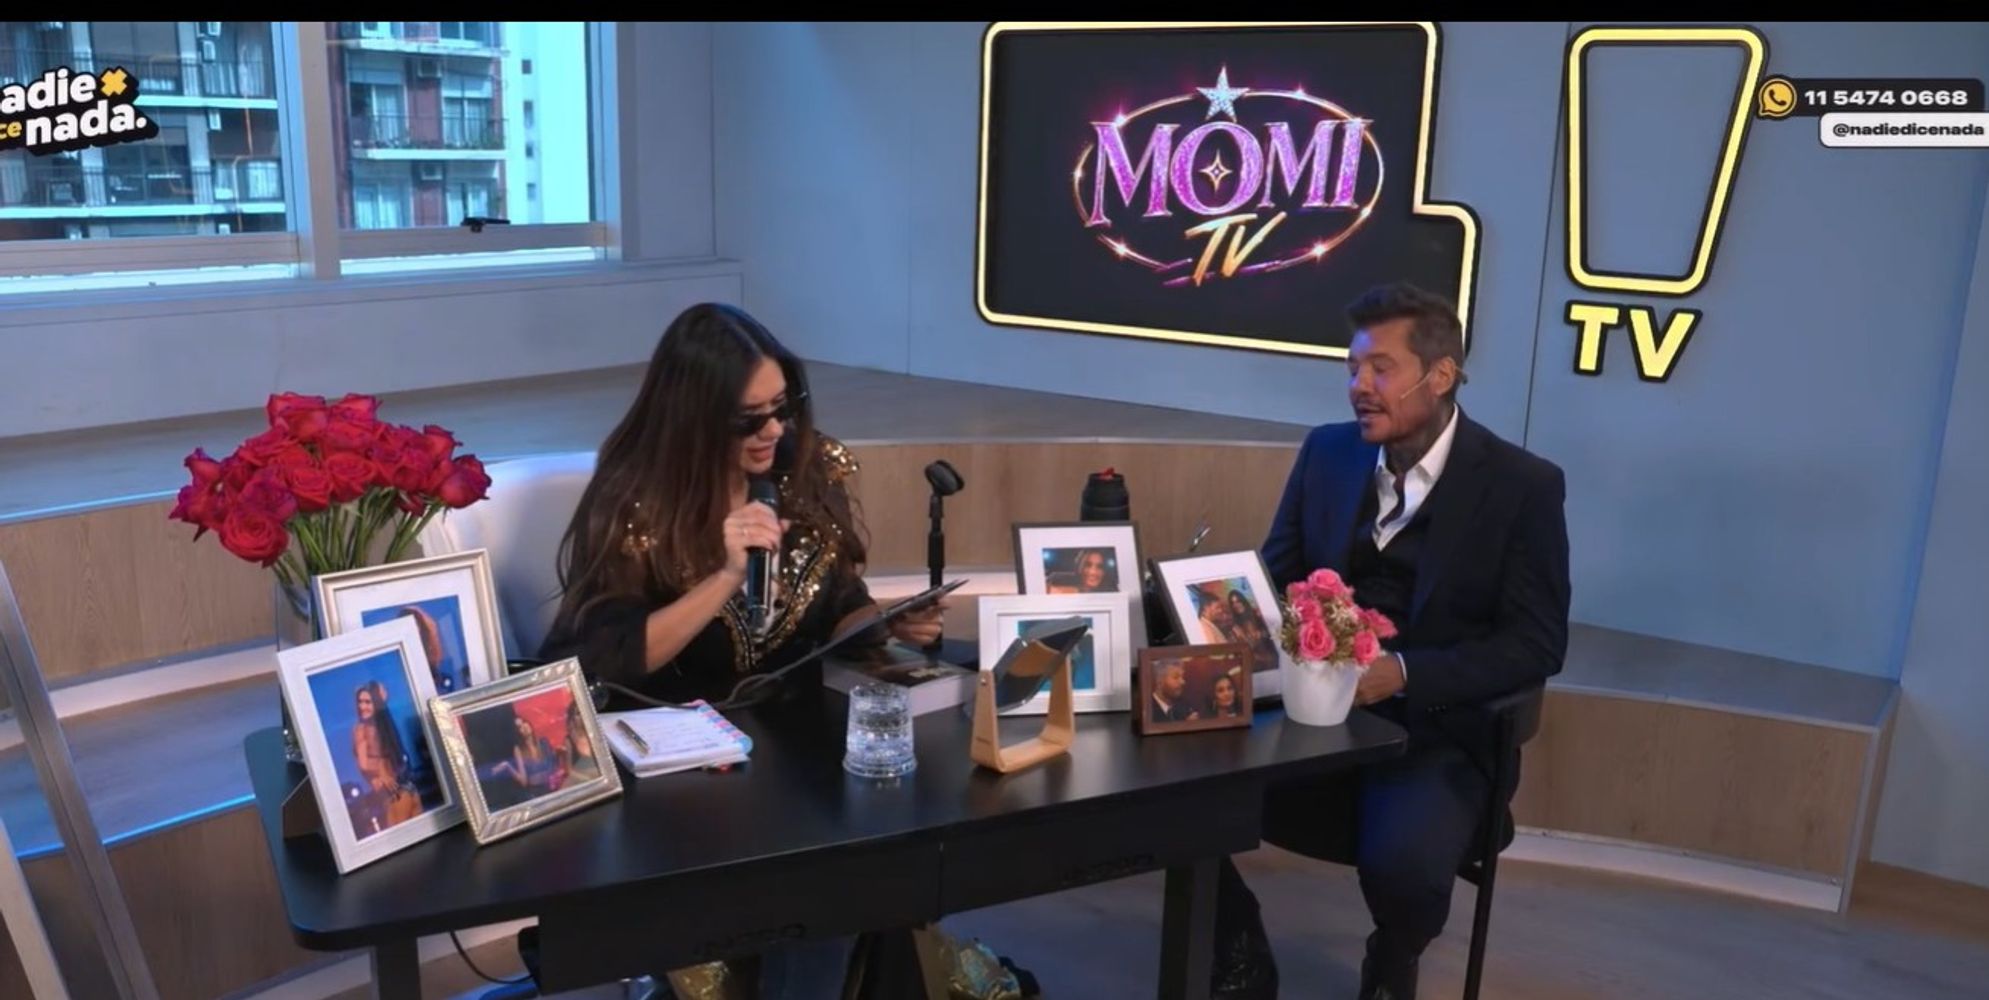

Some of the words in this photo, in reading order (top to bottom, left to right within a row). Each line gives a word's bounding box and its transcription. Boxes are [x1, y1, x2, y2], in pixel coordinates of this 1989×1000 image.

[1085, 119, 1374, 227] MOMI
[1185, 210, 1287, 287] TV
[1569, 304, 1695, 378] TV
